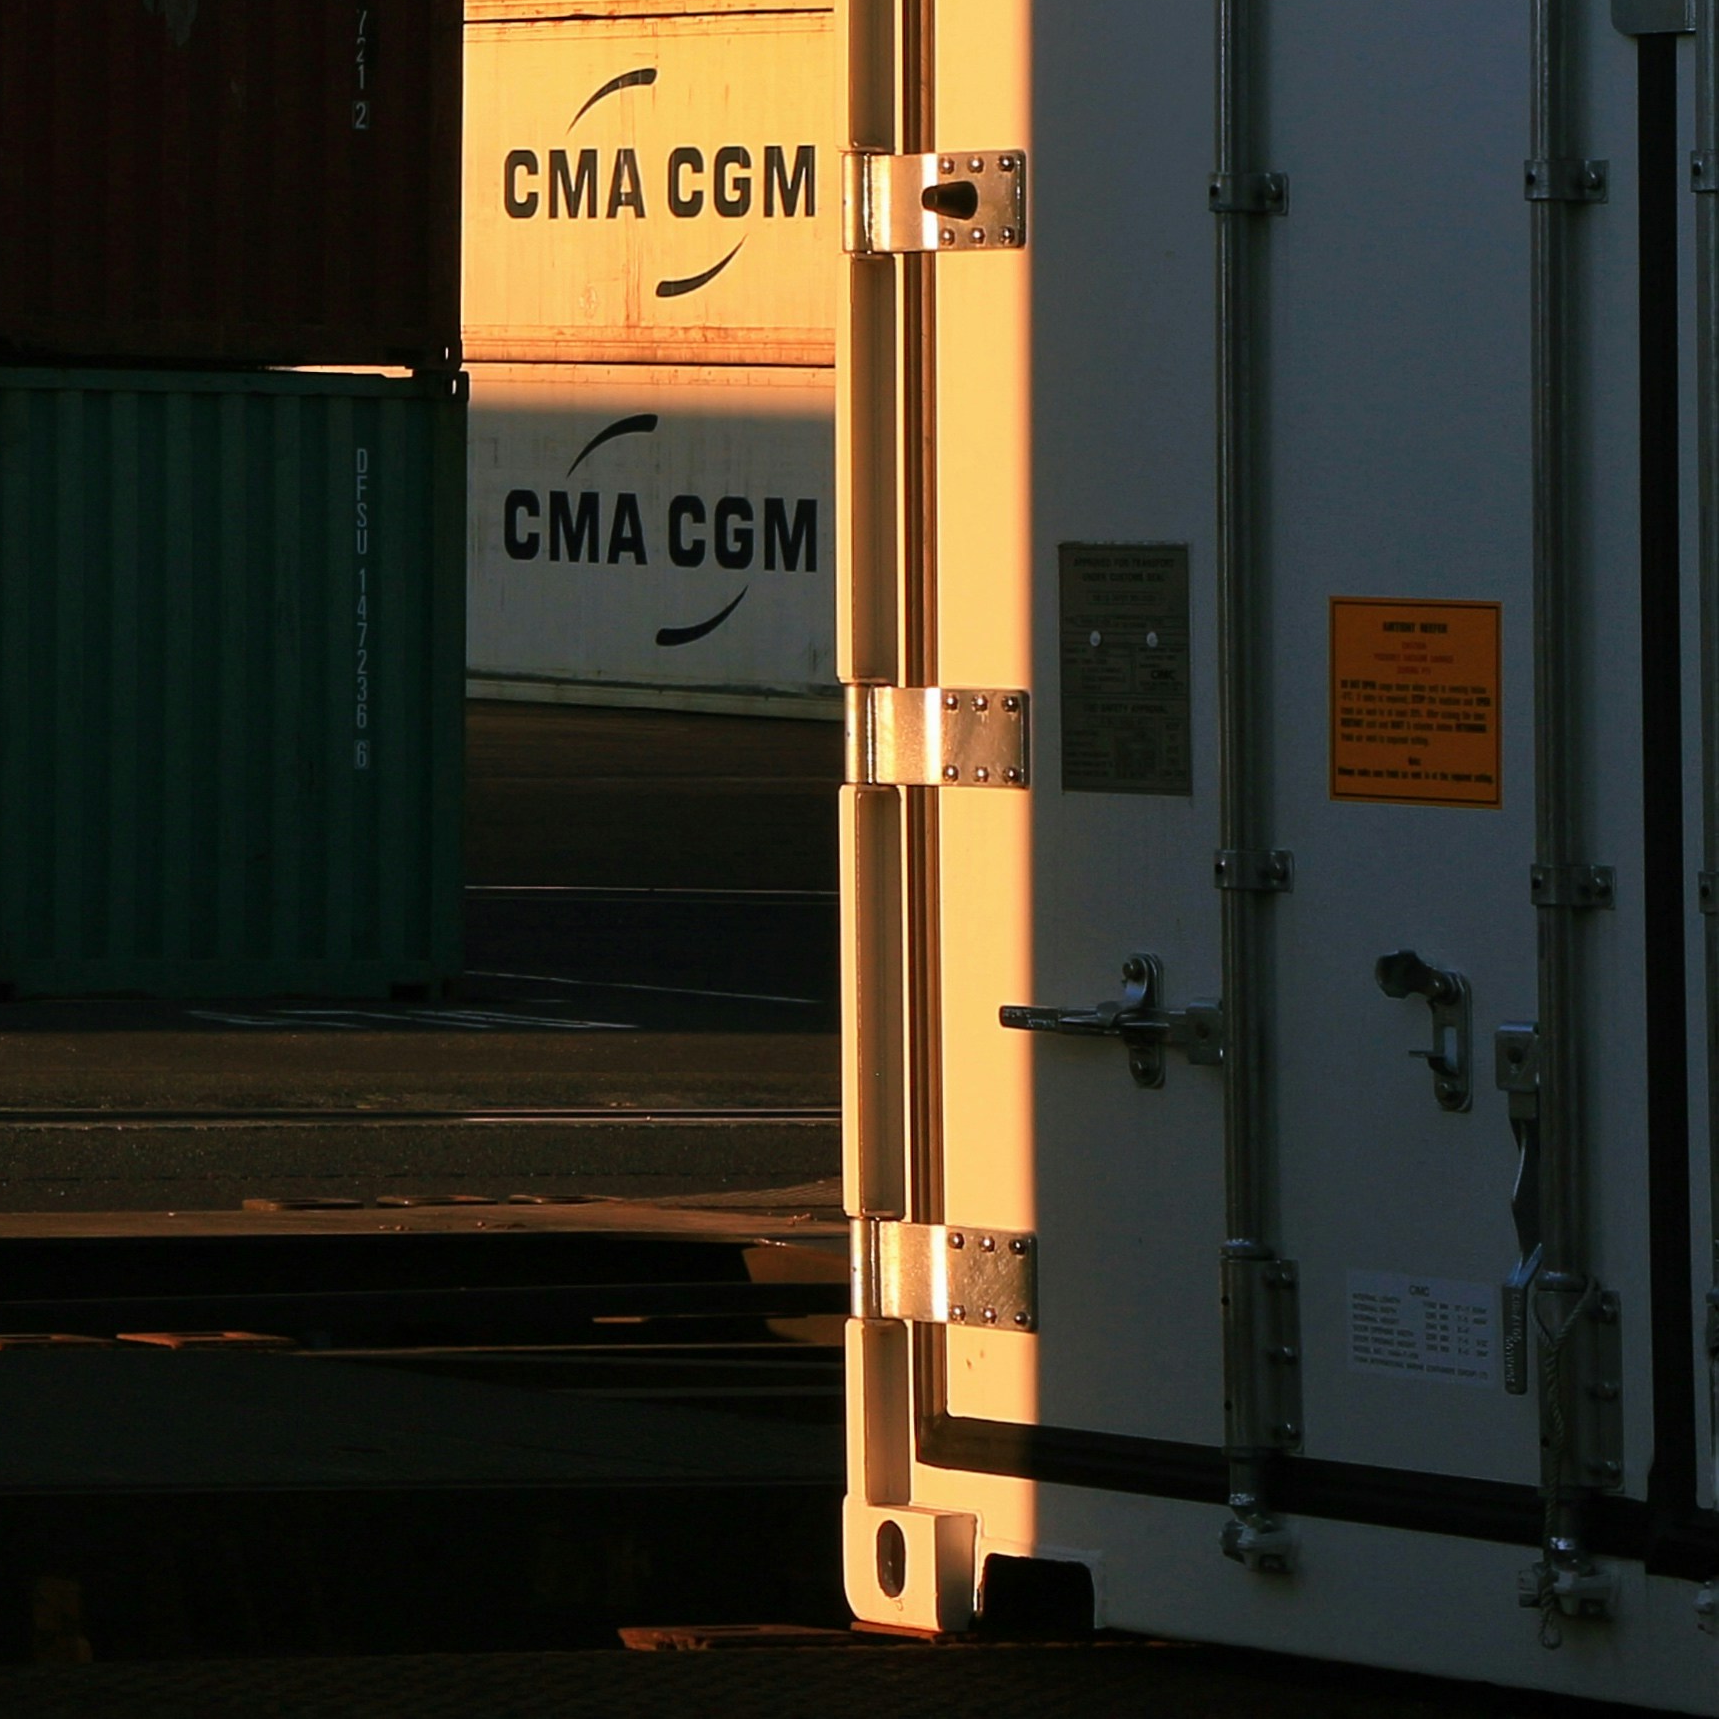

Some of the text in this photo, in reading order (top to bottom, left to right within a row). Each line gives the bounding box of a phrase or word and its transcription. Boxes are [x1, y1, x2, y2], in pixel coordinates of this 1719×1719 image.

[355, 103, 368, 129] 2
[504, 144, 817, 220] CMA CGM
[503, 488, 818, 573] CMA CGM
[356, 448, 368, 768] DFSU 147236 6
